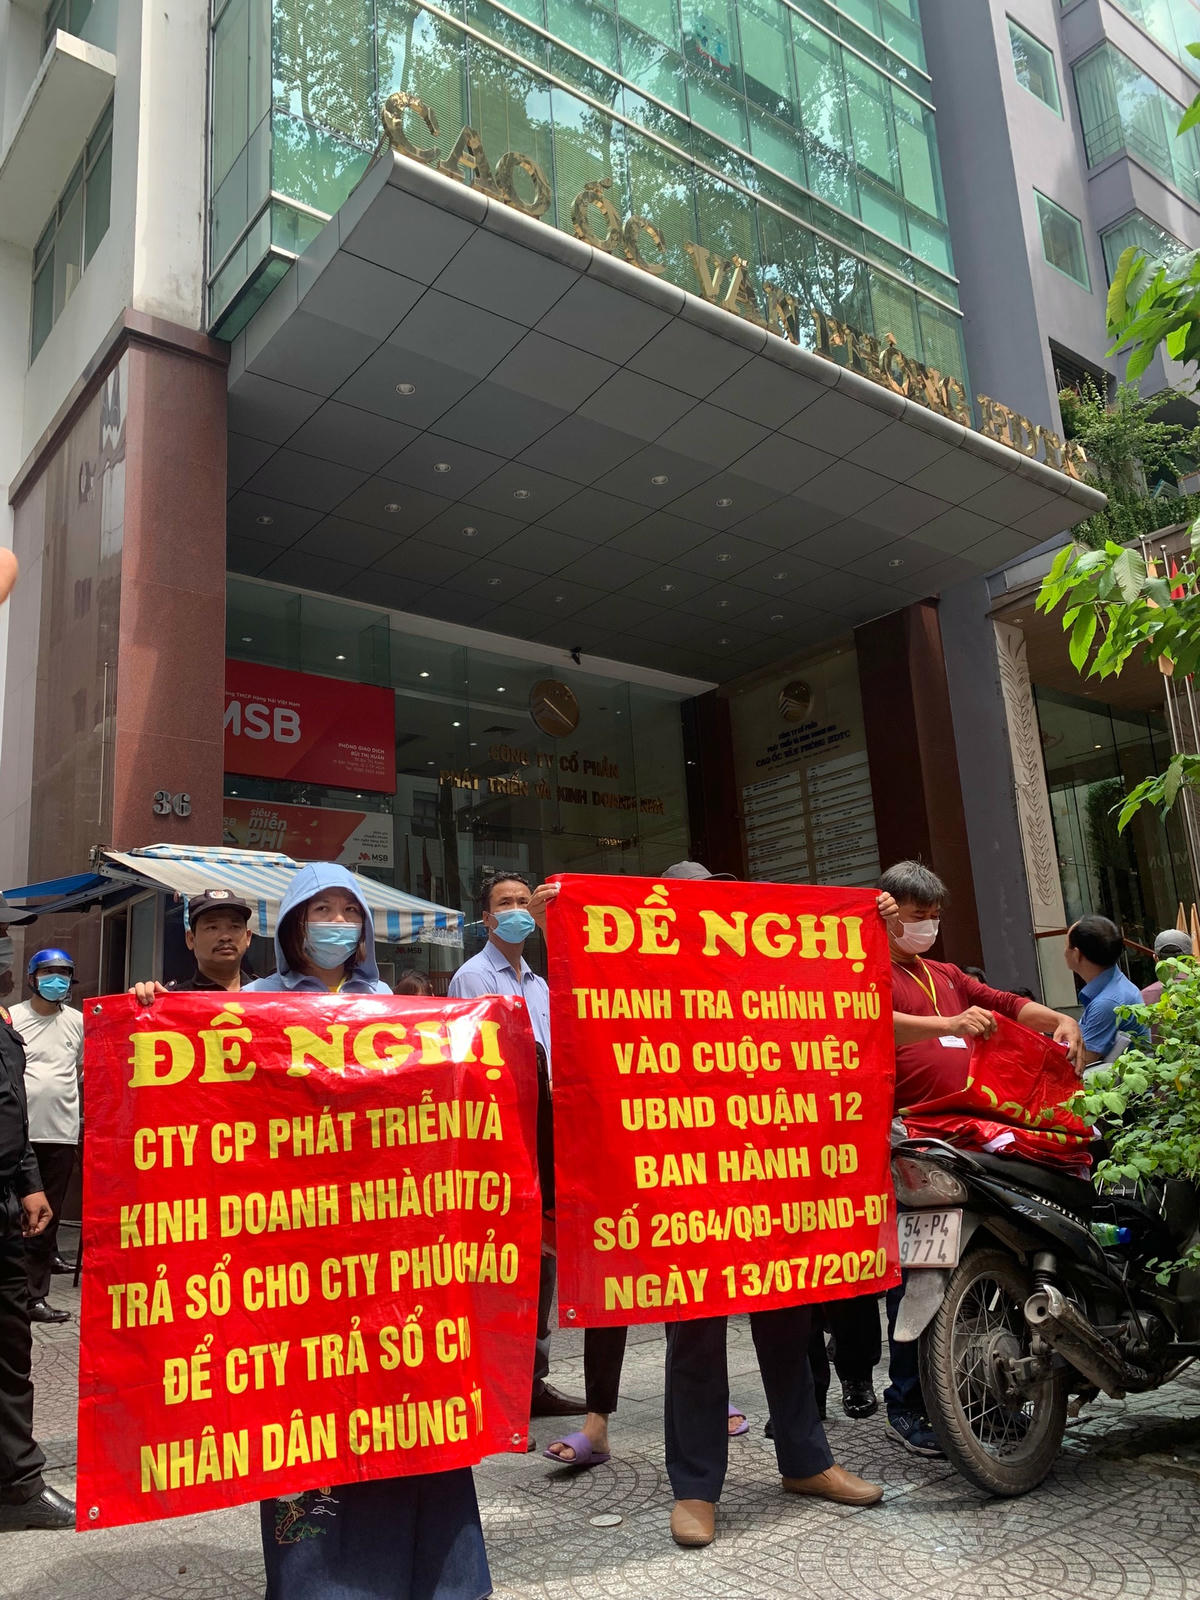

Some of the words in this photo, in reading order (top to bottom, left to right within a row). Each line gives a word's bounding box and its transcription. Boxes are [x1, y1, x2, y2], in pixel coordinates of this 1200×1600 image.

[381, 91, 551, 216] CAO
[152, 790, 192, 818] 36
[372, 854, 389, 862] MSB
[583, 884, 681, 956] ĐỀ
[699, 908, 868, 974] NGHỊ
[573, 988, 671, 1020] THANH
[680, 989, 734, 1020] TRA
[742, 984, 827, 1020] CHÍNH
[833, 982, 881, 1021] PHỦ
[127, 1002, 257, 1088] ĐỀ
[284, 1020, 506, 1081] NGHỊ
[613, 1035, 681, 1075] VÀO
[692, 1035, 782, 1079] CUỘC
[791, 1034, 861, 1078] VIỆC
[133, 1124, 199, 1171] CTY
[210, 1120, 257, 1164] CP
[269, 1106, 354, 1159] PHÁT
[464, 1094, 504, 1141] VÀ
[620, 1096, 716, 1132] UBND
[727, 1087, 819, 1132] QUẬN
[829, 1092, 864, 1122] 12
[634, 1152, 709, 1190] BAN
[718, 1143, 812, 1183] HÀNH
[820, 1143, 860, 1178] QĐ
[120, 1192, 208, 1249] KINH
[220, 1184, 340, 1238] DOANH
[593, 1203, 641, 1252] SỐ
[650, 1193, 889, 1249] 2664/QĐ-UBND-ĐT
[904, 1212, 950, 1238] 54-P4
[604, 1264, 710, 1312] NGÀY
[721, 1247, 888, 1300] 13/07/2020
[899, 1237, 948, 1264] 9774
[107, 1262, 174, 1330] TRẢ
[185, 1252, 232, 1320] SỔ
[242, 1261, 310, 1312] CHO
[320, 1251, 380, 1301] CTY
[162, 1333, 214, 1406] ĐỂ
[225, 1340, 290, 1395] CTY
[301, 1315, 369, 1381] TRẢ
[378, 1304, 424, 1371] SỔ
[140, 1425, 249, 1493] NHÂN
[262, 1408, 338, 1472] DÂN
[348, 1392, 468, 1455] CHÚNG
